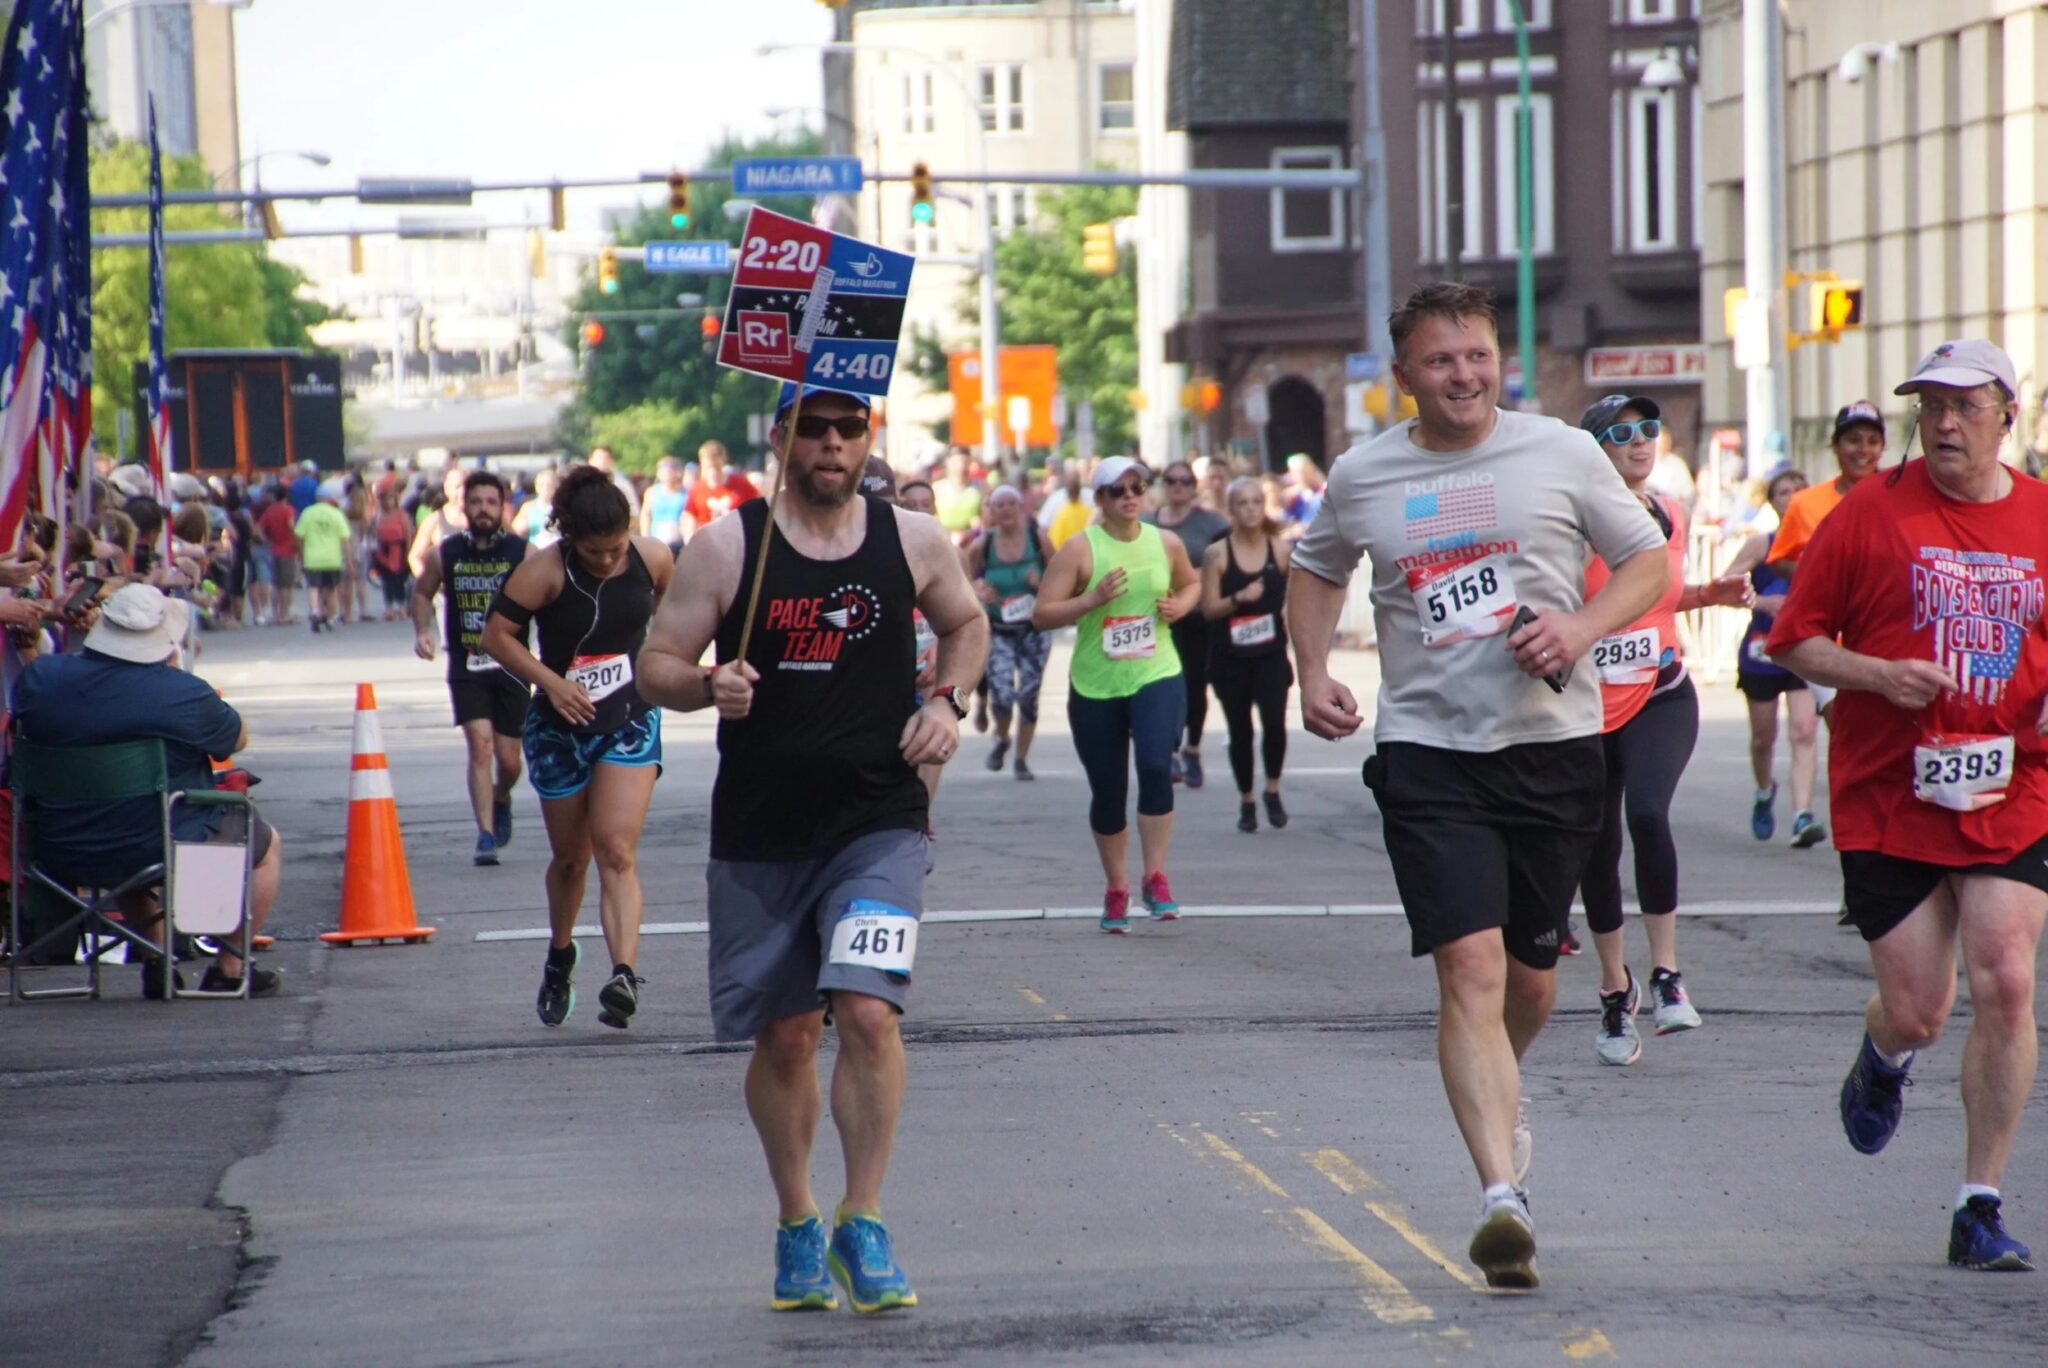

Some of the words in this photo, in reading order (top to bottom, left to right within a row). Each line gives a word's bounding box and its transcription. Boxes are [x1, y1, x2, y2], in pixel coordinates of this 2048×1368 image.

[745, 164, 834, 184] NIAGARA
[667, 246, 711, 263] EAGLE
[743, 236, 821, 273] 2:20
[744, 321, 783, 348] Rr
[813, 352, 890, 380] 4:40
[1404, 472, 1495, 496] buffalo
[1427, 529, 1477, 551] half
[1395, 540, 1519, 569] marathon
[454, 576, 505, 592] BROOKLY
[1427, 566, 1498, 623] 5158
[1432, 573, 1456, 591] David
[1912, 563, 1966, 632] BOYS
[1968, 583, 1984, 616] &
[766, 598, 824, 630] PACE
[783, 630, 844, 660] TEAM
[1112, 622, 1151, 648] 5375
[1950, 617, 2006, 654] CLUB
[1594, 637, 1651, 667] 2933
[1924, 750, 2003, 785] 2393
[849, 928, 905, 955] 461
